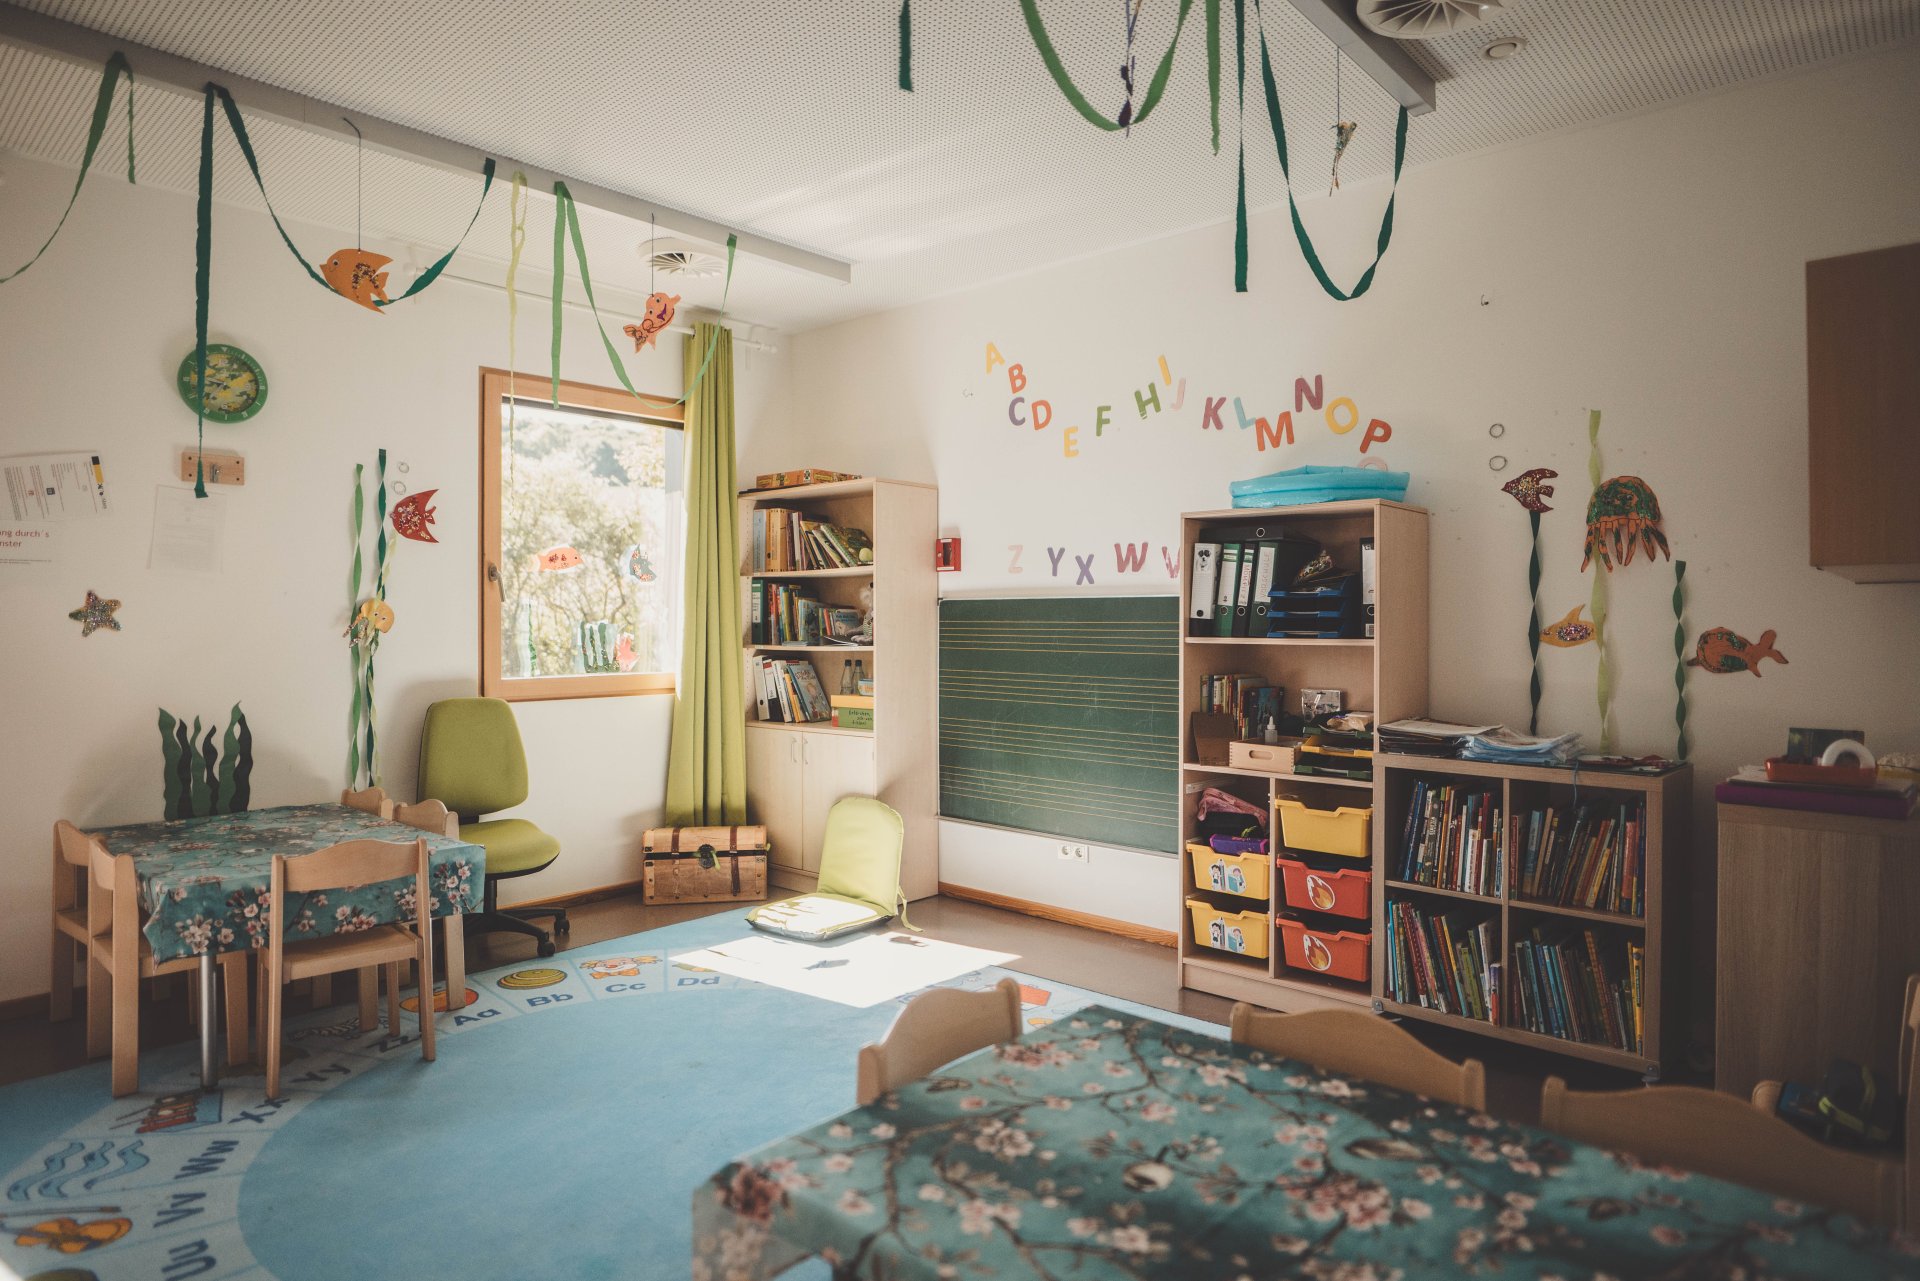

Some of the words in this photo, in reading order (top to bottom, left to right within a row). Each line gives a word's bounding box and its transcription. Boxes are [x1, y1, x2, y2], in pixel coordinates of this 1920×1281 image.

[604, 982, 647, 993] Cc
[677, 976, 721, 987] Dd
[526, 992, 574, 1008] Bb
[453, 1008, 502, 1027] Aa
